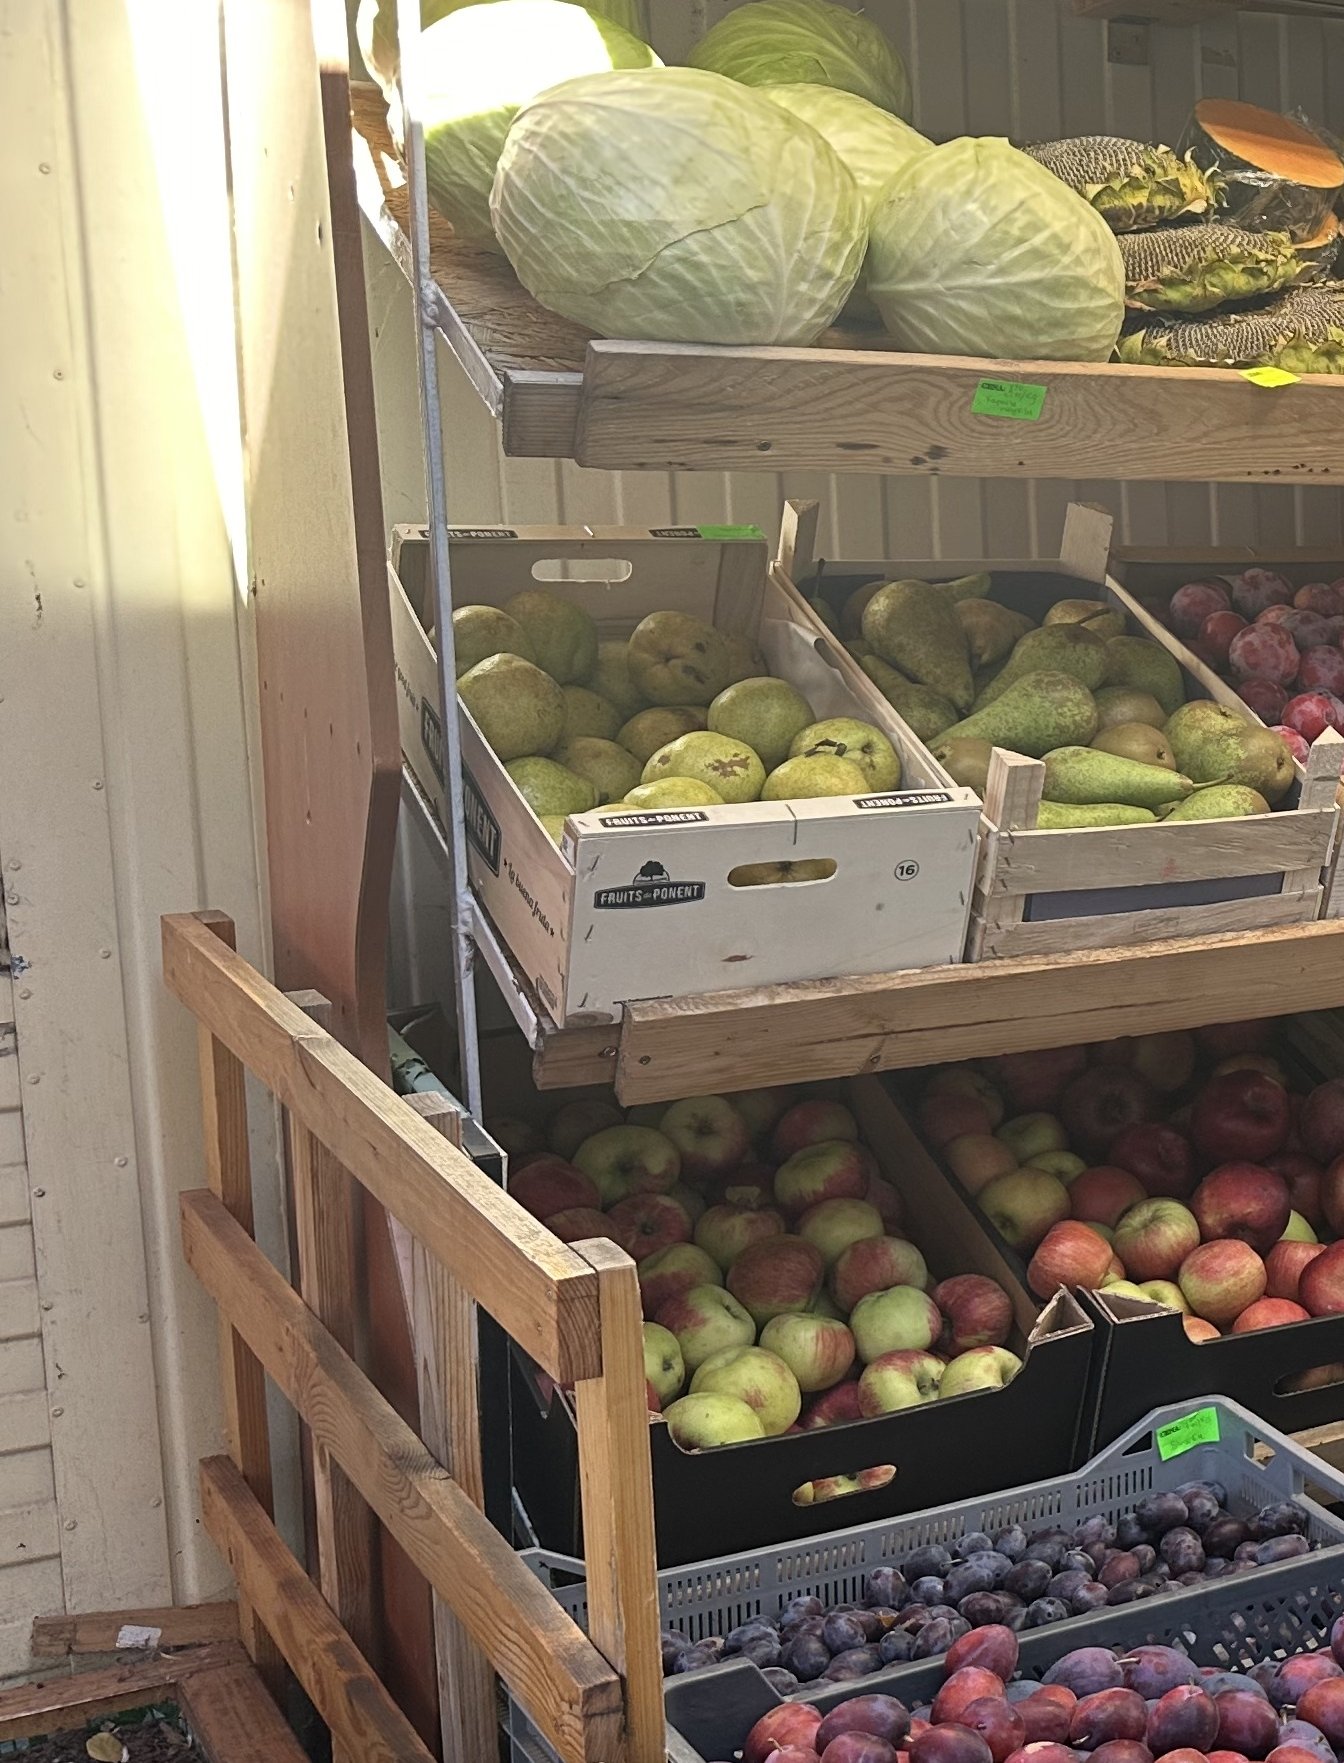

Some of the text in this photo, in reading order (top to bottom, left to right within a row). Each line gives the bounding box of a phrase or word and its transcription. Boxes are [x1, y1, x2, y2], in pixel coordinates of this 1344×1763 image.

[463, 784, 498, 858] ONENT
[605, 814, 648, 826] FRUITS
[656, 812, 702, 823] PONENT
[899, 865, 915, 876] 16
[600, 890, 643, 906] FRUITS
[652, 885, 701, 901] PONENT
